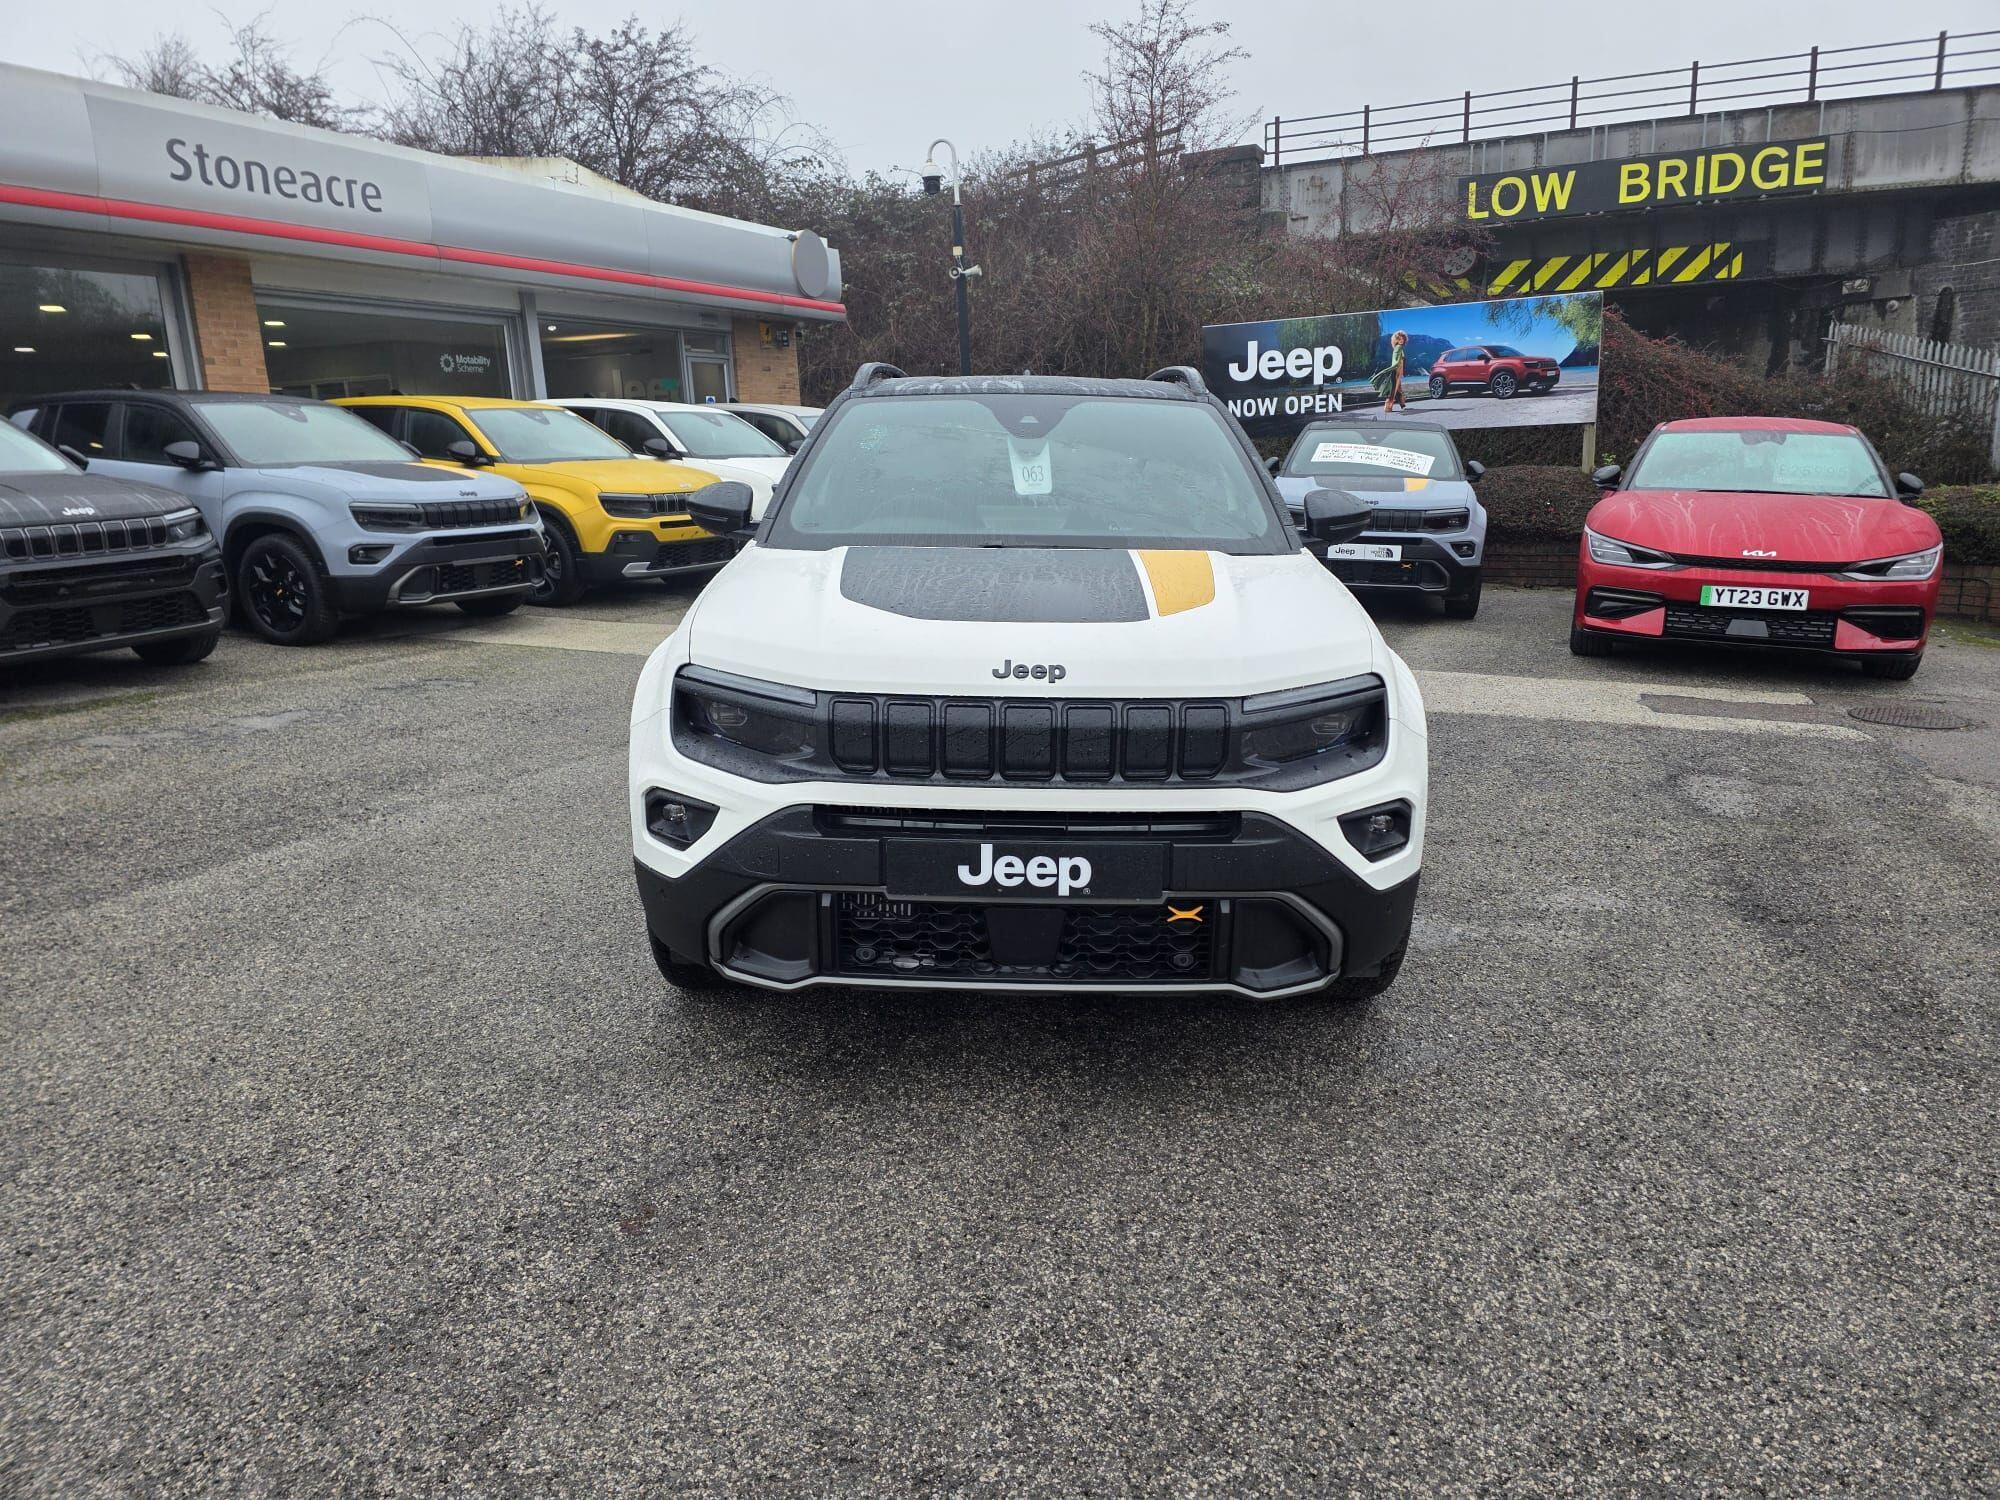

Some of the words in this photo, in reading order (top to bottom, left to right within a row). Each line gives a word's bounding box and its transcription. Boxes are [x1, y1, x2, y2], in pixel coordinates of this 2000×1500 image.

[166, 138, 383, 213] Stoneacre
[1467, 170, 1576, 220] LOW
[1618, 143, 1825, 204] BRIDGE
[1228, 340, 1343, 386] Jeep
[1228, 397, 1278, 418] NOW
[1285, 393, 1343, 415] OPEN
[1022, 465, 1044, 481] 063
[62, 507, 95, 516] Jeep
[1335, 546, 1356, 556] Jeep
[1716, 588, 1762, 605] YT23
[1768, 591, 1805, 607] GWX
[992, 659, 1066, 683] Jeep
[957, 843, 1092, 897] Jeep
